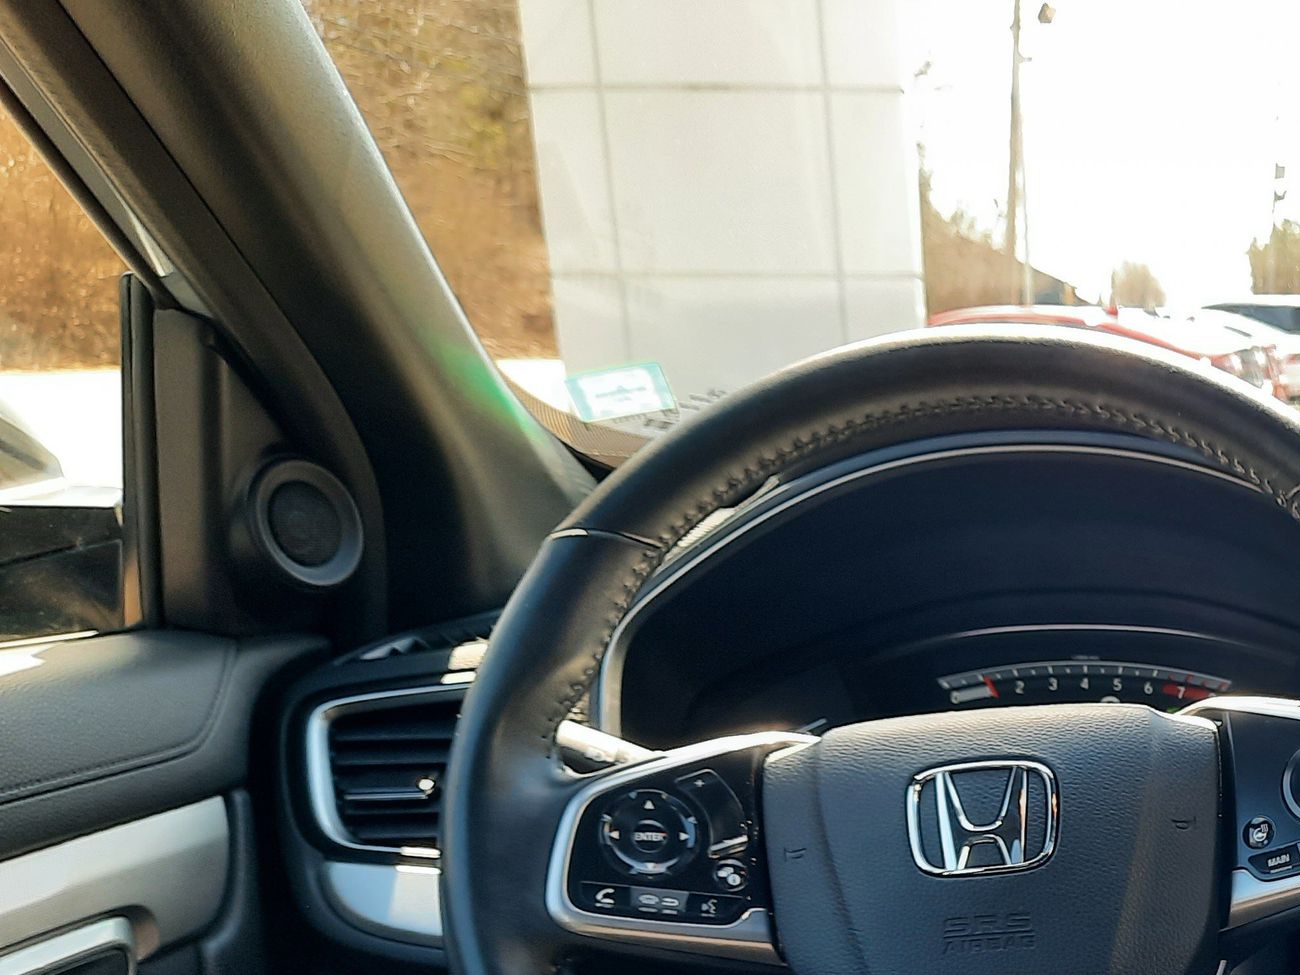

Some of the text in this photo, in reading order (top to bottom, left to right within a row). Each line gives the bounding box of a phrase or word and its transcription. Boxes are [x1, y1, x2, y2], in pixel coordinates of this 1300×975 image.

[1015, 681, 1024, 694] 2
[1048, 677, 1058, 691] 3
[1080, 677, 1089, 690] 4
[1113, 677, 1122, 691] 5
[1144, 681, 1153, 695] 6
[1176, 685, 1186, 699] 7
